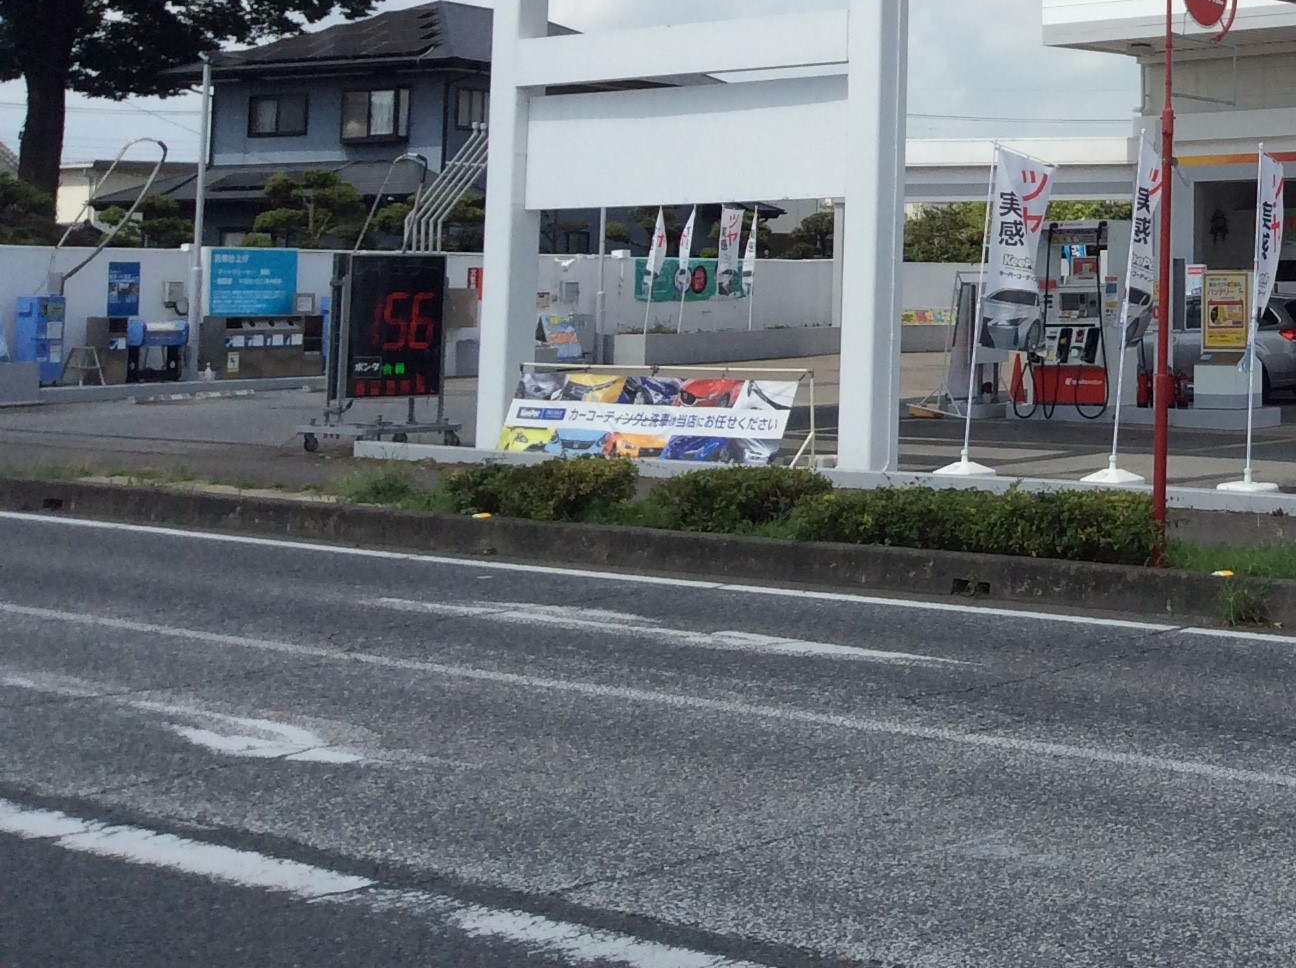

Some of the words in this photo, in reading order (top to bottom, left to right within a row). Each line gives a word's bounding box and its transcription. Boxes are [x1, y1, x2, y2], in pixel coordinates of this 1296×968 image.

[998, 191, 1024, 246] 実感
[1021, 170, 1048, 233] ツヤ
[371, 291, 435, 350] 156
